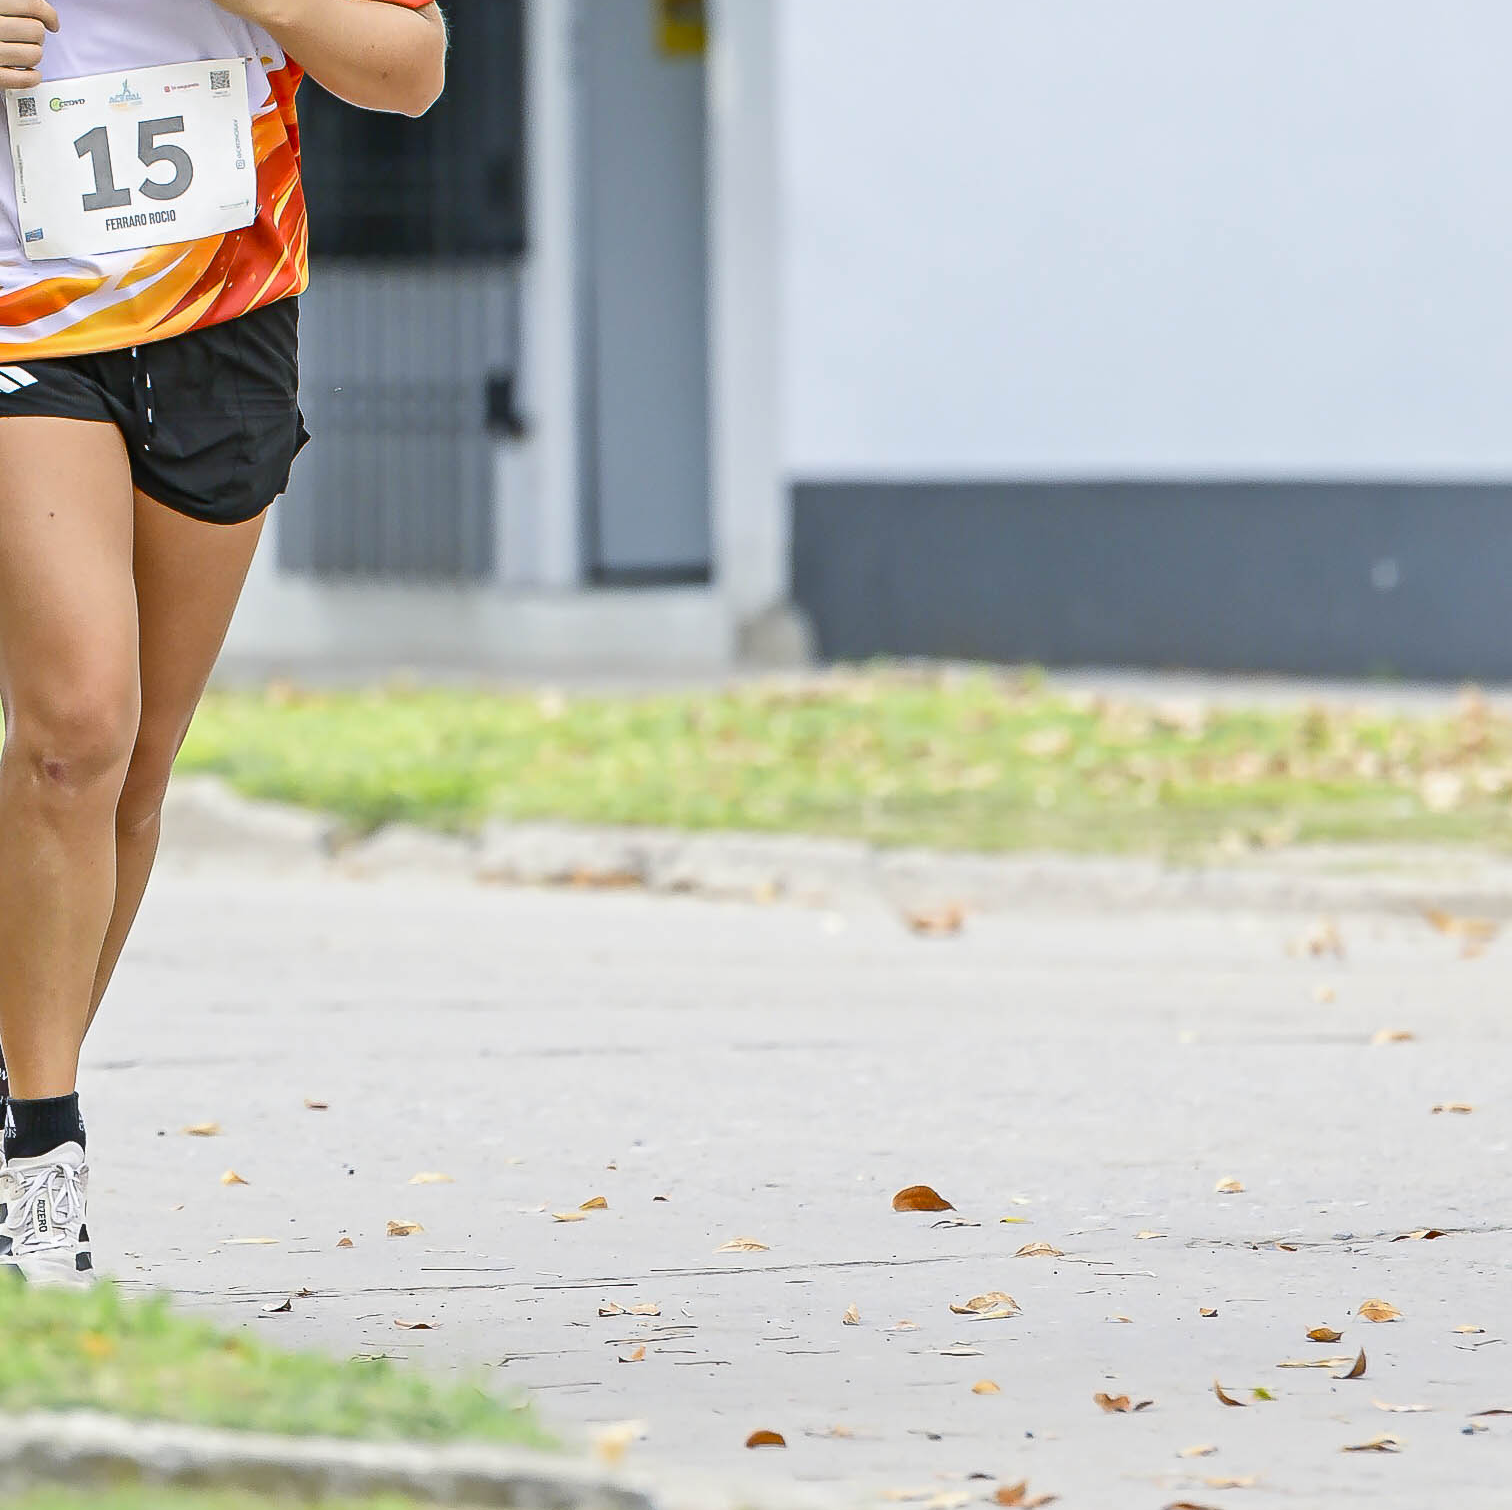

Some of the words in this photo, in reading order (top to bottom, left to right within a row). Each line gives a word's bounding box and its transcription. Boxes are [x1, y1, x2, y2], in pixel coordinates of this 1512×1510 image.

[74, 115, 194, 212] 15
[105, 213, 147, 231] FERRARO
[149, 209, 177, 224] ROCIO
